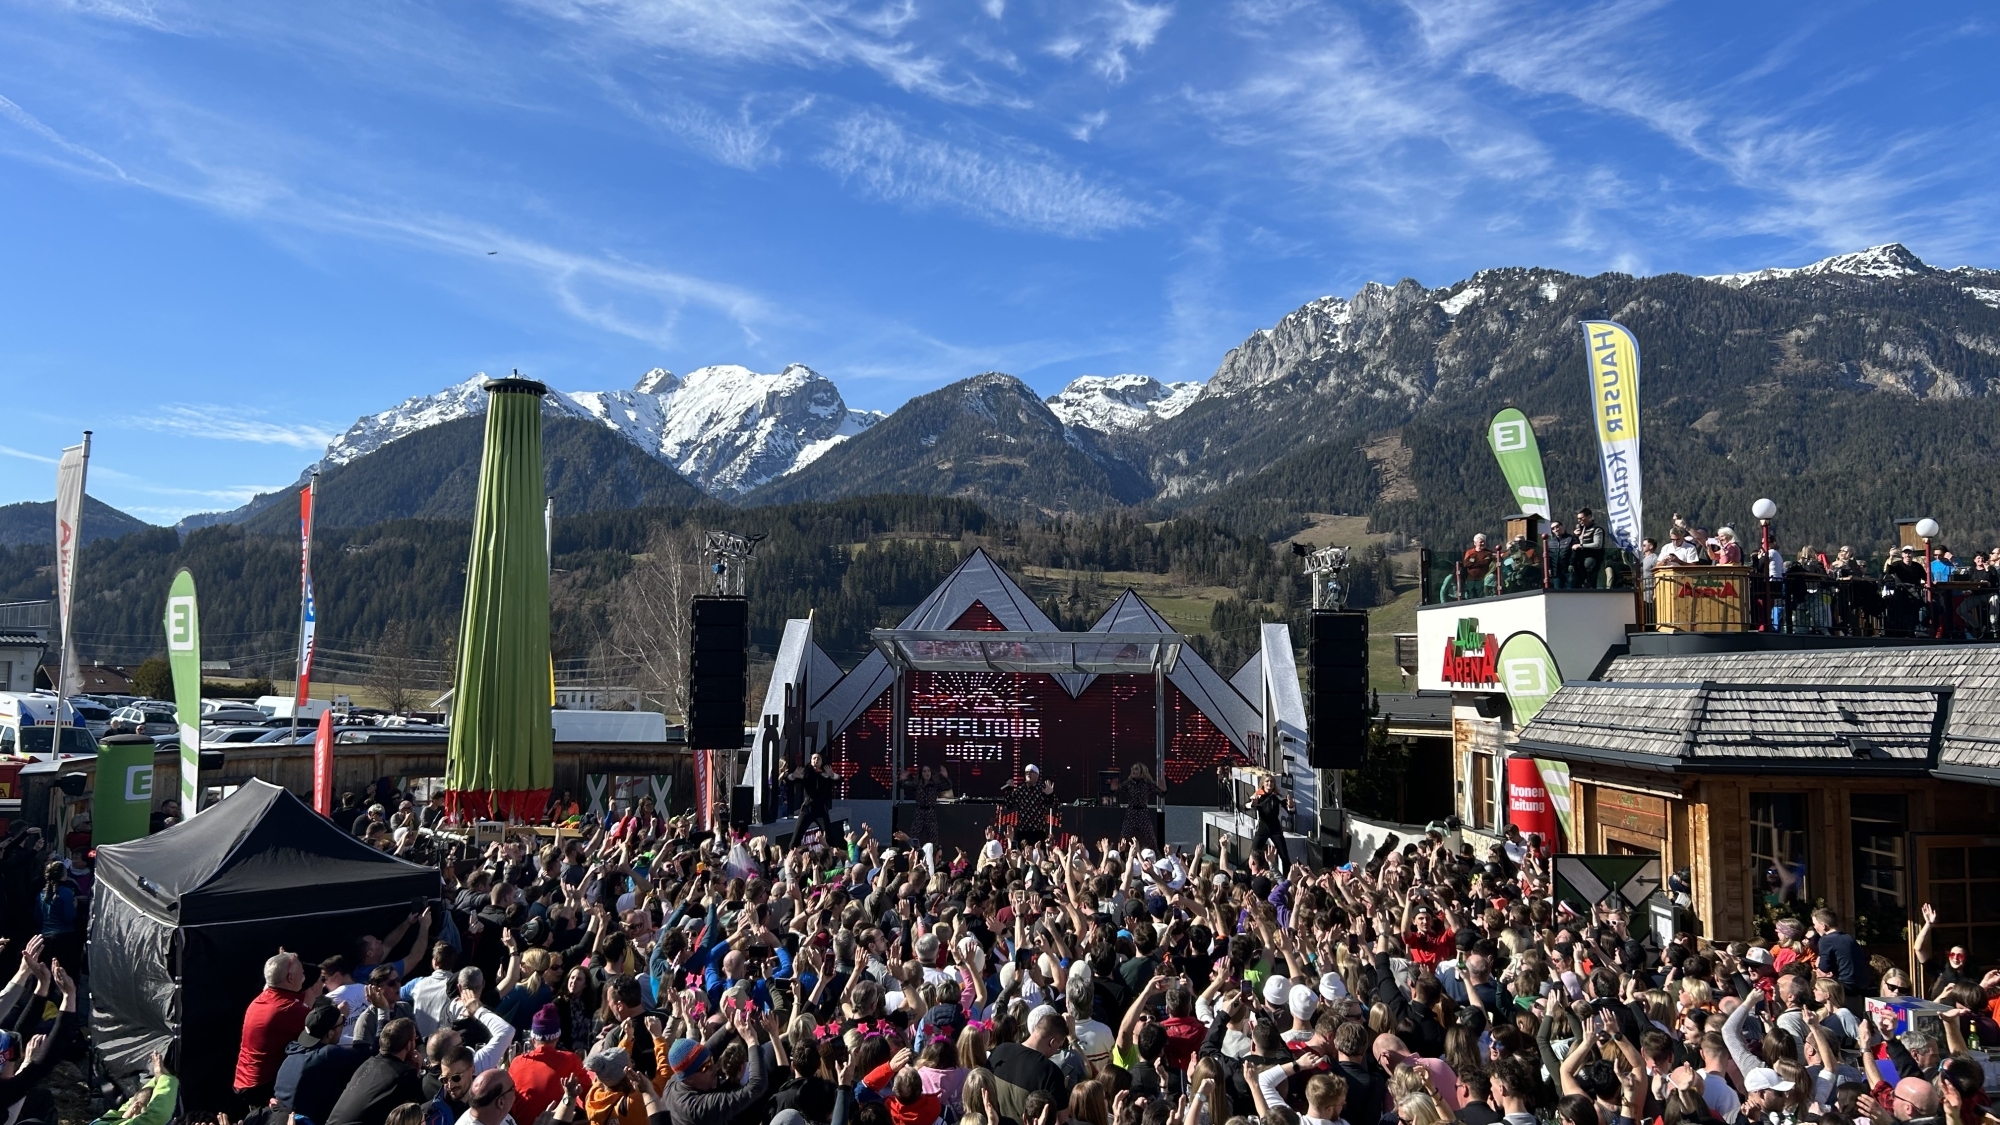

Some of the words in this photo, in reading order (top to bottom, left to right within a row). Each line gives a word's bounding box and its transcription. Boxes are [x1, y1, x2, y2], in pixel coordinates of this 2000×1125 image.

[907, 717, 1041, 738] GIPFELTOUR
[1510, 784, 1545, 798] Kronen
[1510, 797, 1545, 813] Zeitung
